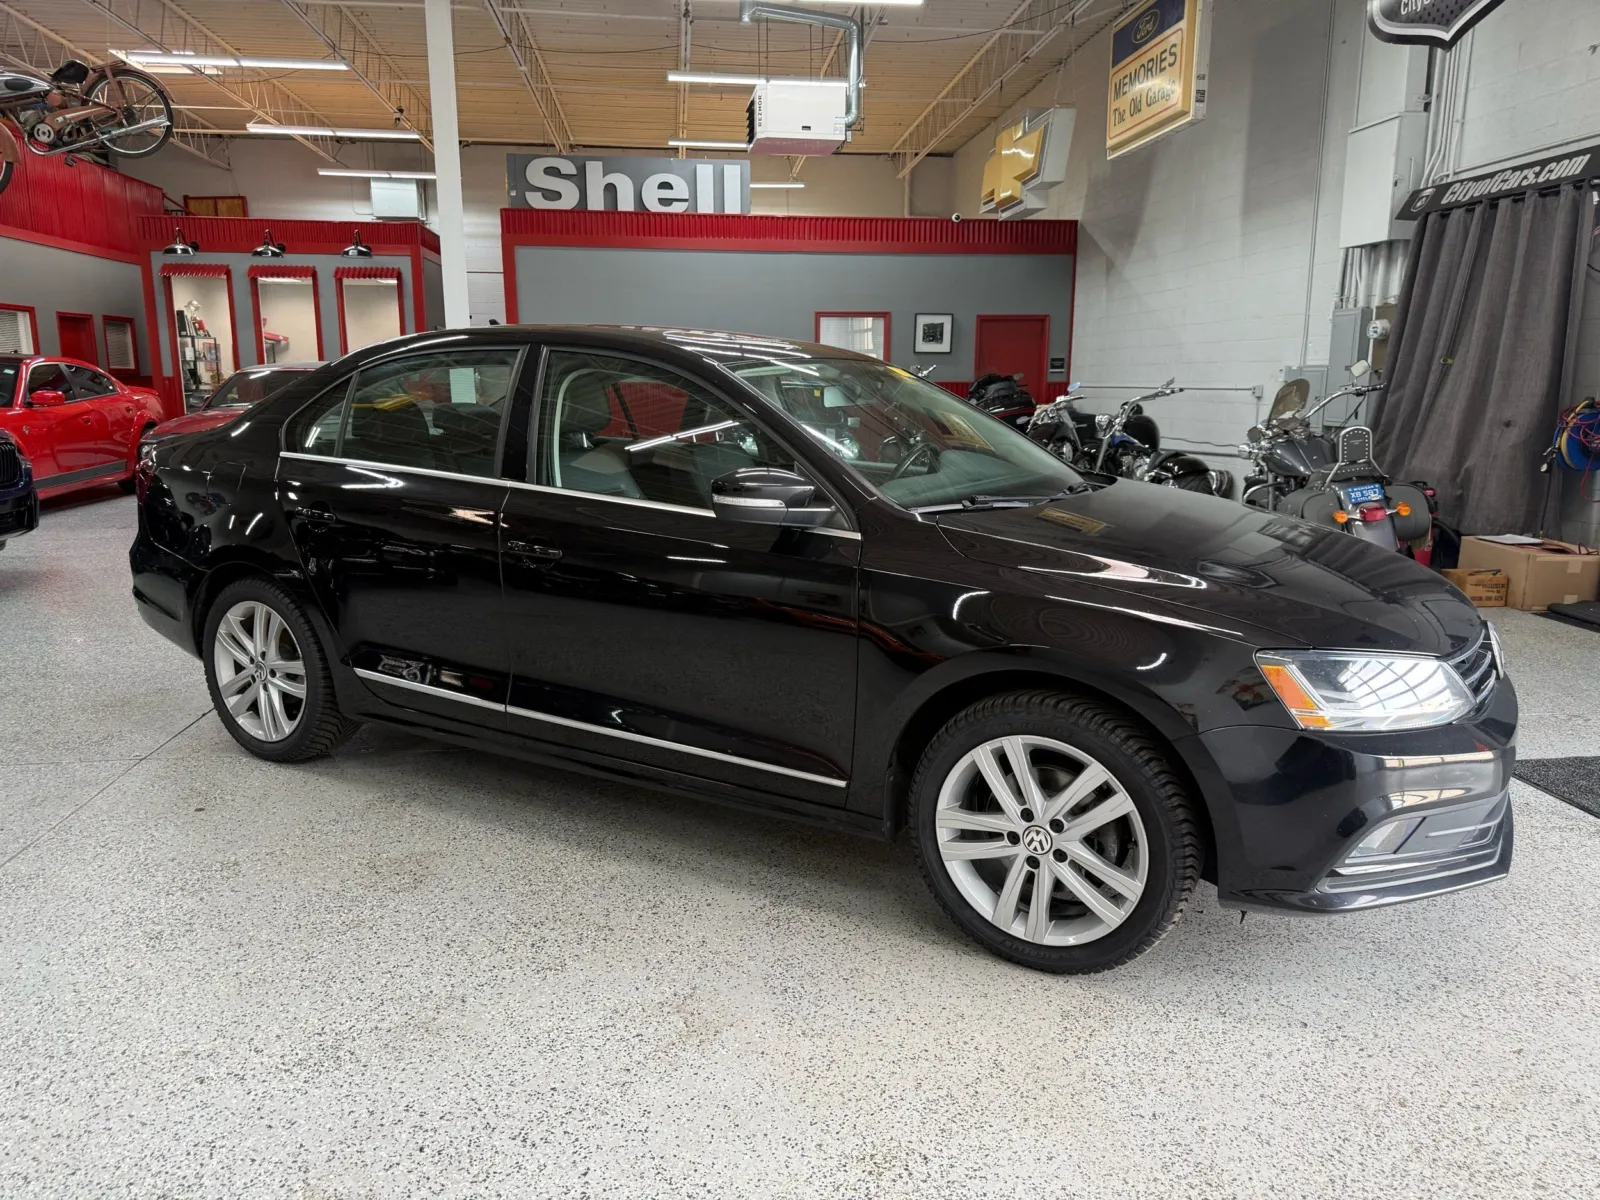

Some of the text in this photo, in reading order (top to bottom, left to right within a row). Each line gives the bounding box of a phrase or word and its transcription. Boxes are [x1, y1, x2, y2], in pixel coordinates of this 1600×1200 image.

[1113, 43, 1178, 102] MEMORIES
[1112, 107, 1126, 127] The
[1129, 93, 1142, 118] Old
[1145, 78, 1176, 108] Garage
[524, 156, 742, 214] Shell
[1440, 153, 1592, 205] CityofCars.com
